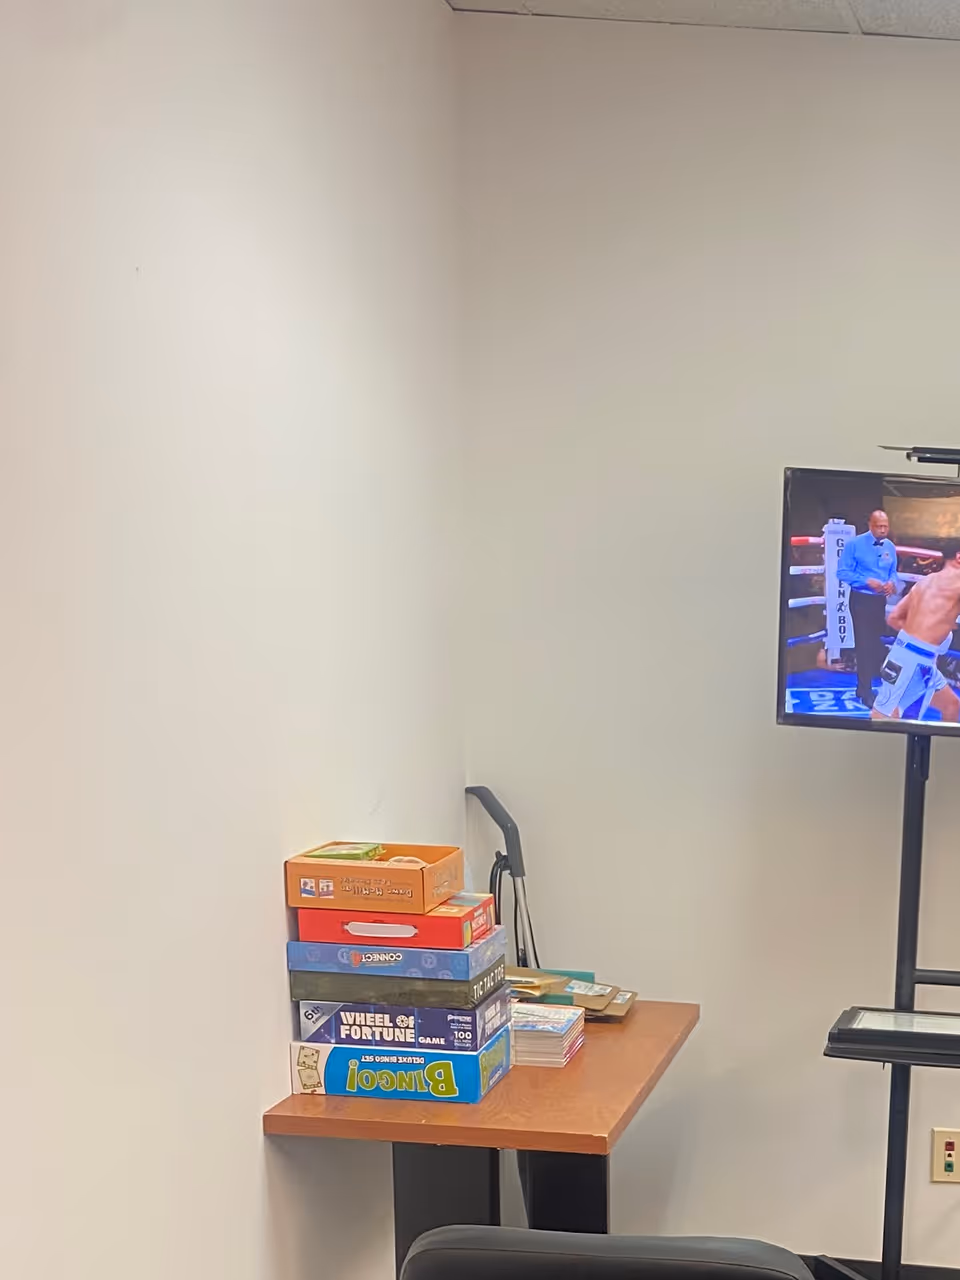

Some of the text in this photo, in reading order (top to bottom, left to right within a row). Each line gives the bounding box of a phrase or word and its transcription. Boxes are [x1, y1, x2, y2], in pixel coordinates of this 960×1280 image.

[361, 951, 403, 962] CONNECT
[473, 981, 483, 1000] TIC
[484, 972, 494, 992] TAC
[303, 1004, 324, 1021] 6th
[340, 1011, 394, 1027] WHEEL
[340, 1024, 416, 1043] FORTUNE
[418, 1036, 446, 1045] GAME
[453, 1031, 472, 1040] 100
[360, 1054, 425, 1064] DELUXE BINGO SET
[345, 1058, 460, 1098] BINGO!
